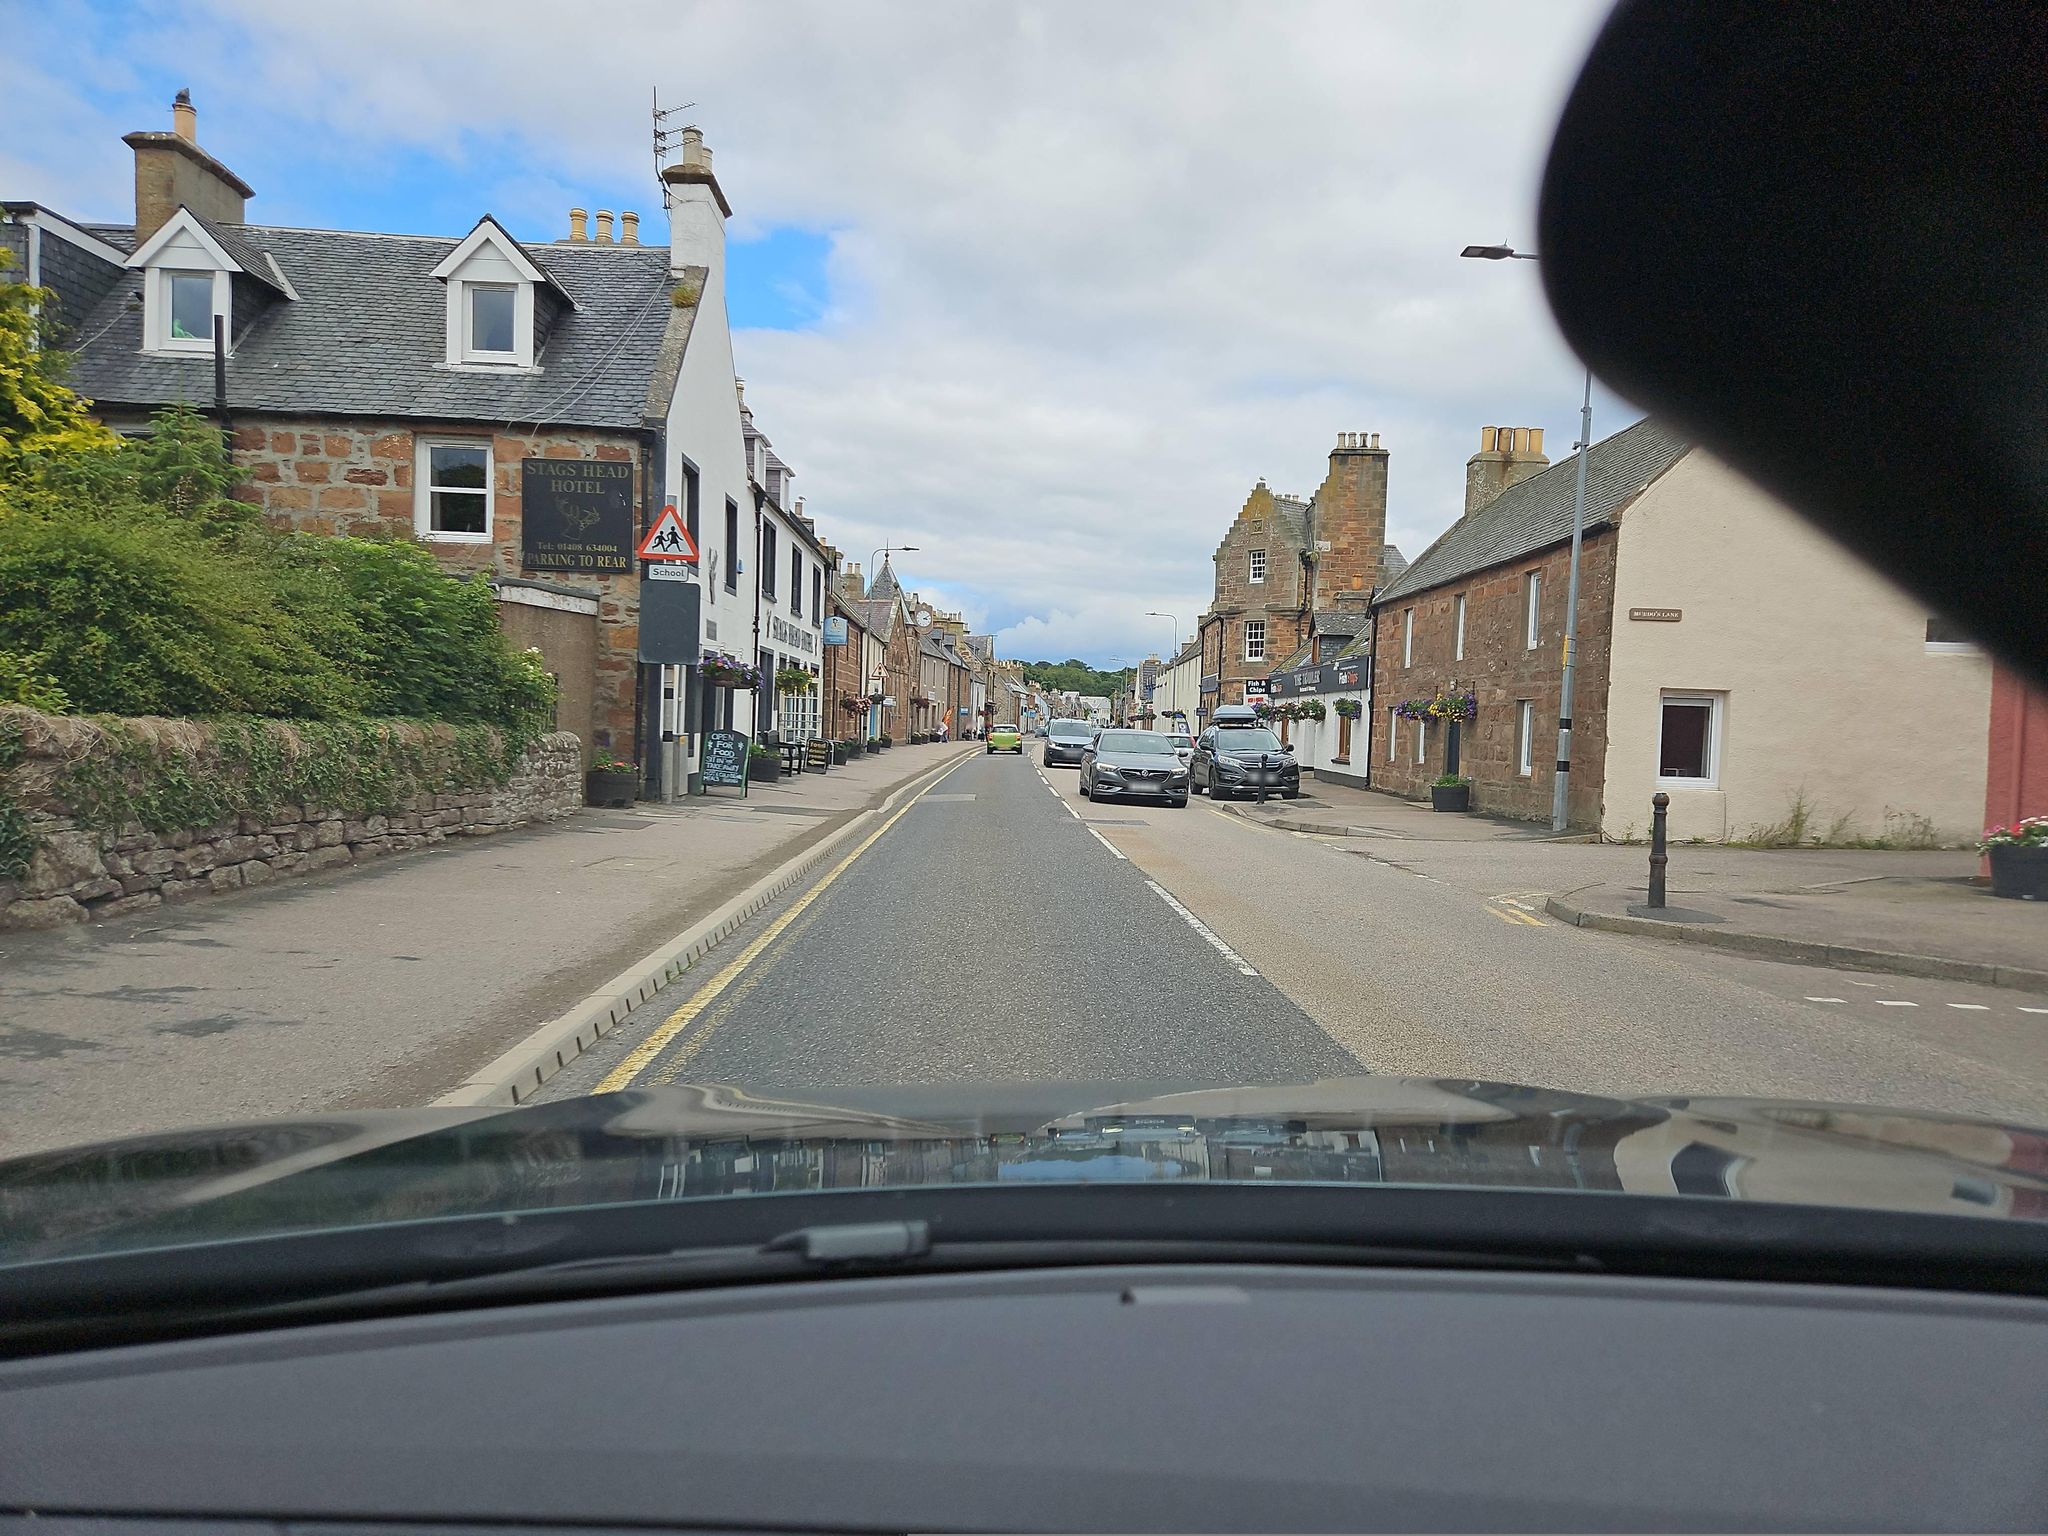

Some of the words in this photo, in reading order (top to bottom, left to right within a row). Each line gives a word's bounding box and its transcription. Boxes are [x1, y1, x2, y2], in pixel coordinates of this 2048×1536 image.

[527, 462, 577, 477] STAGS
[583, 464, 629, 479] HEAD
[551, 479, 605, 495] HOTEL
[537, 542, 555, 551] Tel:
[557, 543, 583, 552] 01408
[585, 544, 617, 553] 634004
[527, 552, 576, 567] PARKING
[579, 555, 594, 567] TO
[597, 555, 627, 568] REAR
[652, 567, 685, 577] School
[1249, 686, 1266, 694] Chips
[711, 733, 735, 741] OPEN
[716, 740, 734, 749] FOR
